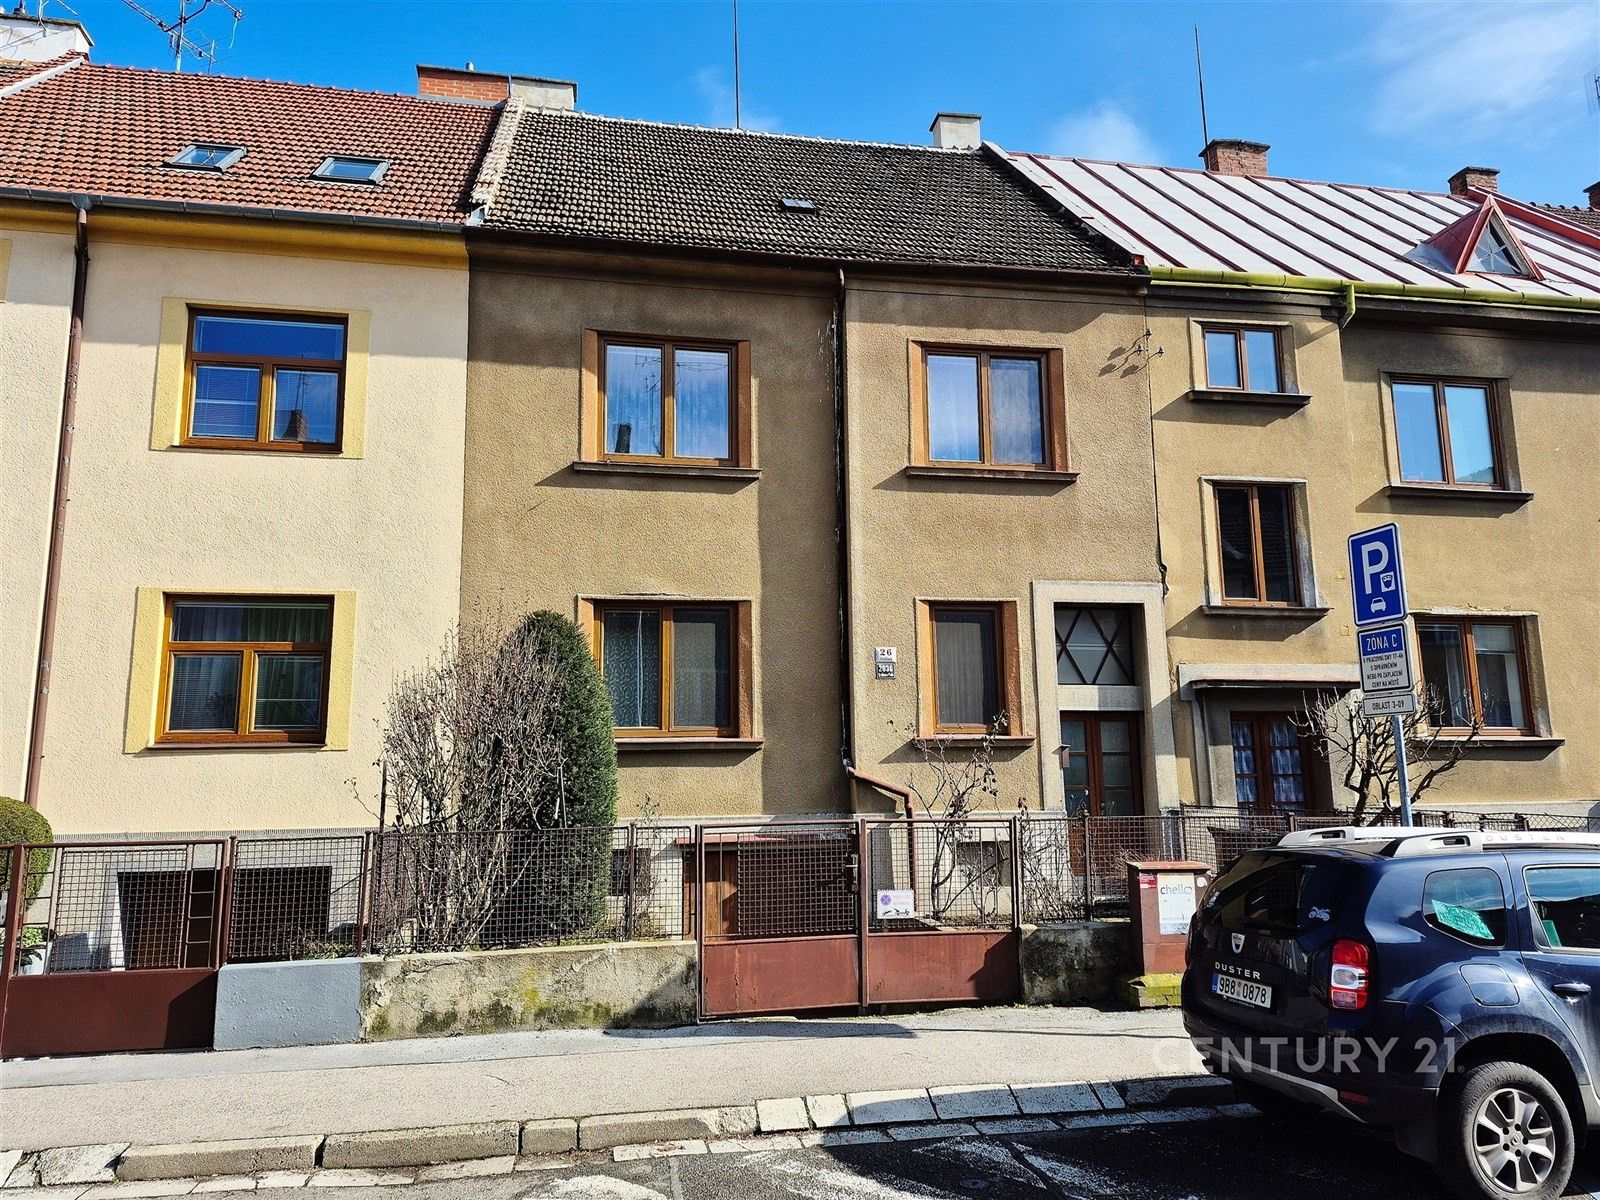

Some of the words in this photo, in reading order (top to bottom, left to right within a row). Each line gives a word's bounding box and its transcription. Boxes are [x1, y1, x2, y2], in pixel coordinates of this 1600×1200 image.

[1361, 540, 1390, 595] P
[879, 648, 892, 656] 26
[1366, 634, 1389, 652] ZÓNA
[1391, 634, 1398, 648] C
[1372, 701, 1390, 710] OBLAST
[1160, 884, 1193, 895] chello
[1215, 961, 1261, 980] DUSTER
[1219, 976, 1236, 996] 9B8
[1242, 983, 1267, 1004] 0878
